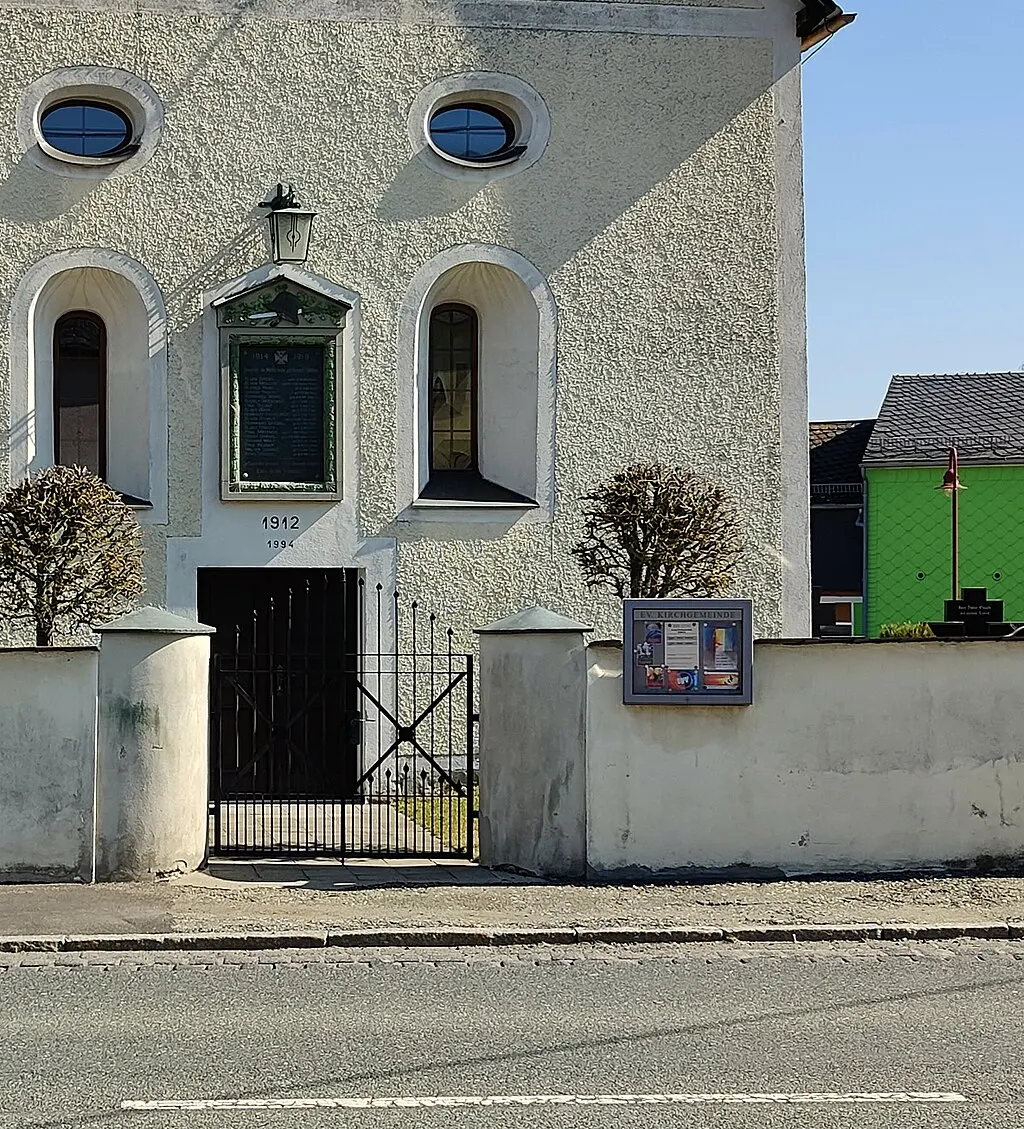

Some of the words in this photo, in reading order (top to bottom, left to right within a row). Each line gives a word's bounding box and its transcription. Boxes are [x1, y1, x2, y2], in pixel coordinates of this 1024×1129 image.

[262, 516, 300, 530] 1912
[267, 540, 294, 549] 1994
[657, 611, 736, 619] KIRCHGEMEINDE
